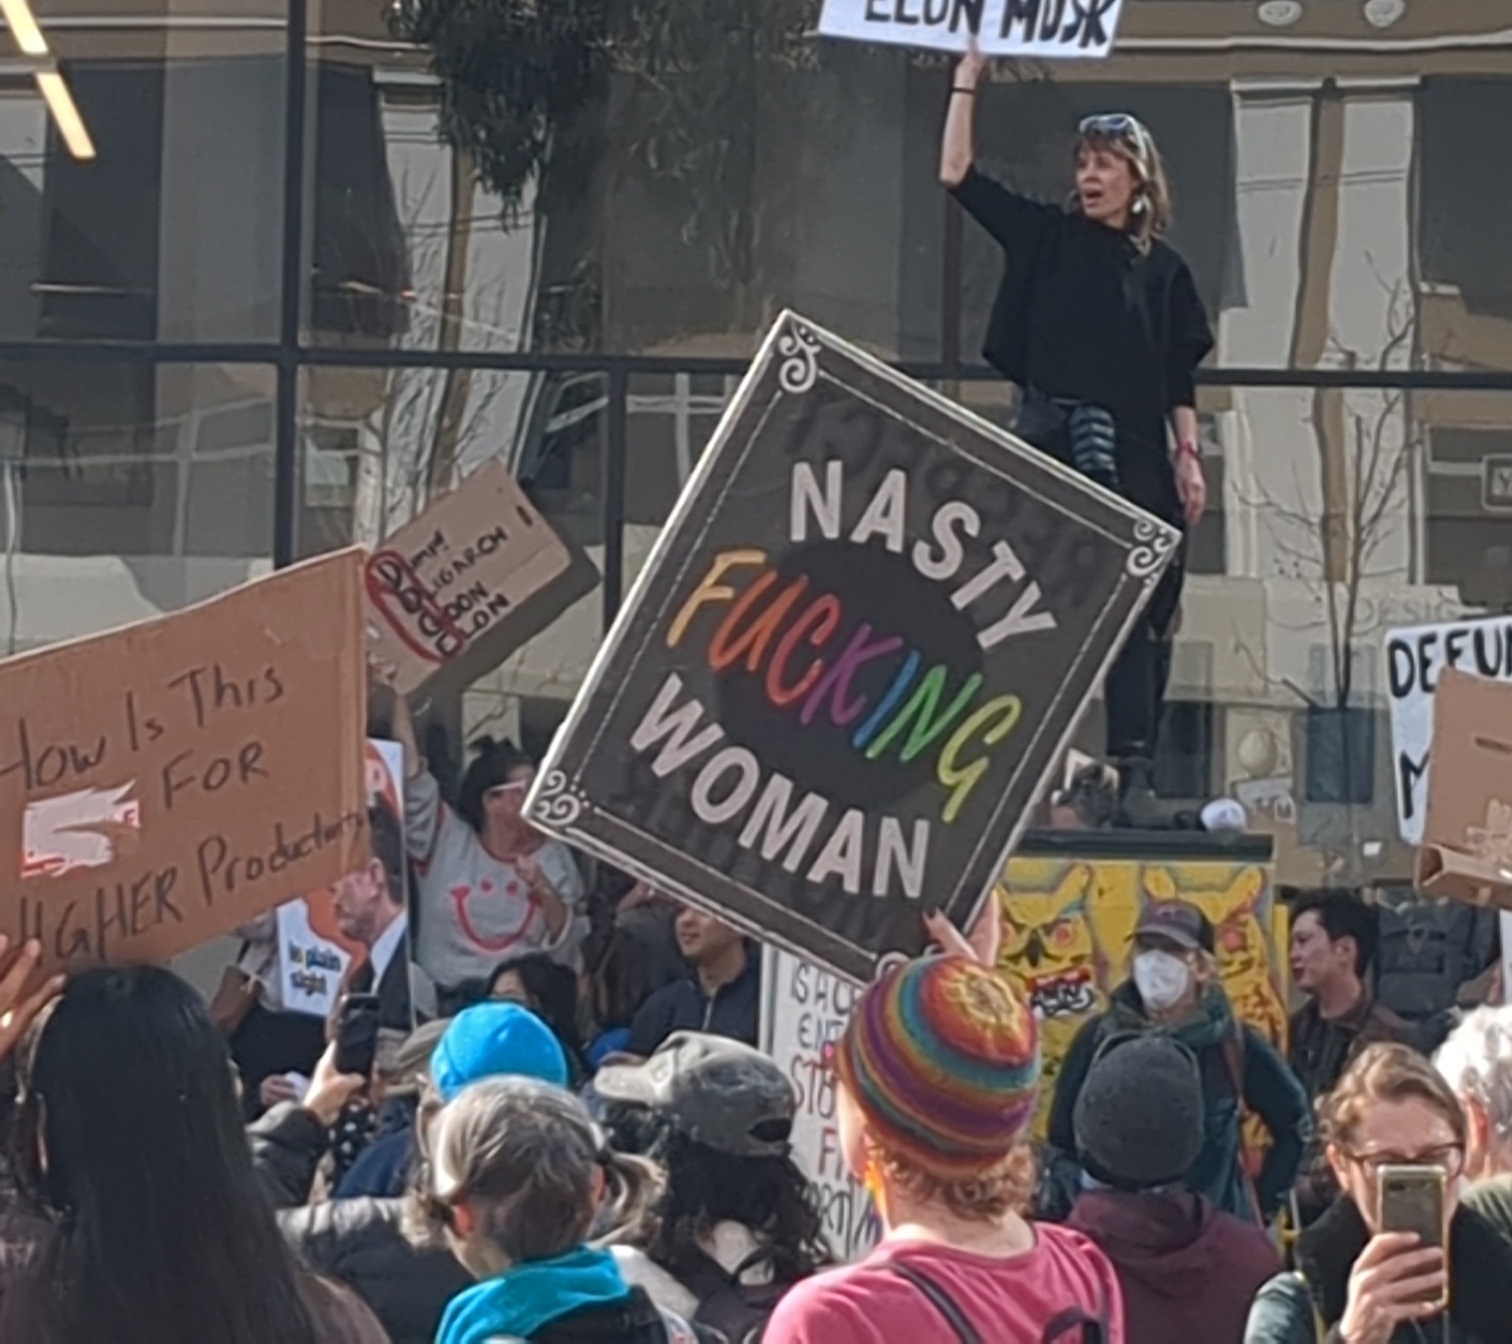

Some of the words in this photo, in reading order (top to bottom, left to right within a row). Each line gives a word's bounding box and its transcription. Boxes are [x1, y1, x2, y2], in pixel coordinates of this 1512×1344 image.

[790, 460, 1058, 649] NASTY
[127, 690, 165, 752] Is
[167, 663, 284, 729] This
[162, 741, 270, 810] FOR
[666, 548, 1021, 823] FUCKING
[629, 672, 931, 899] WOMAN
